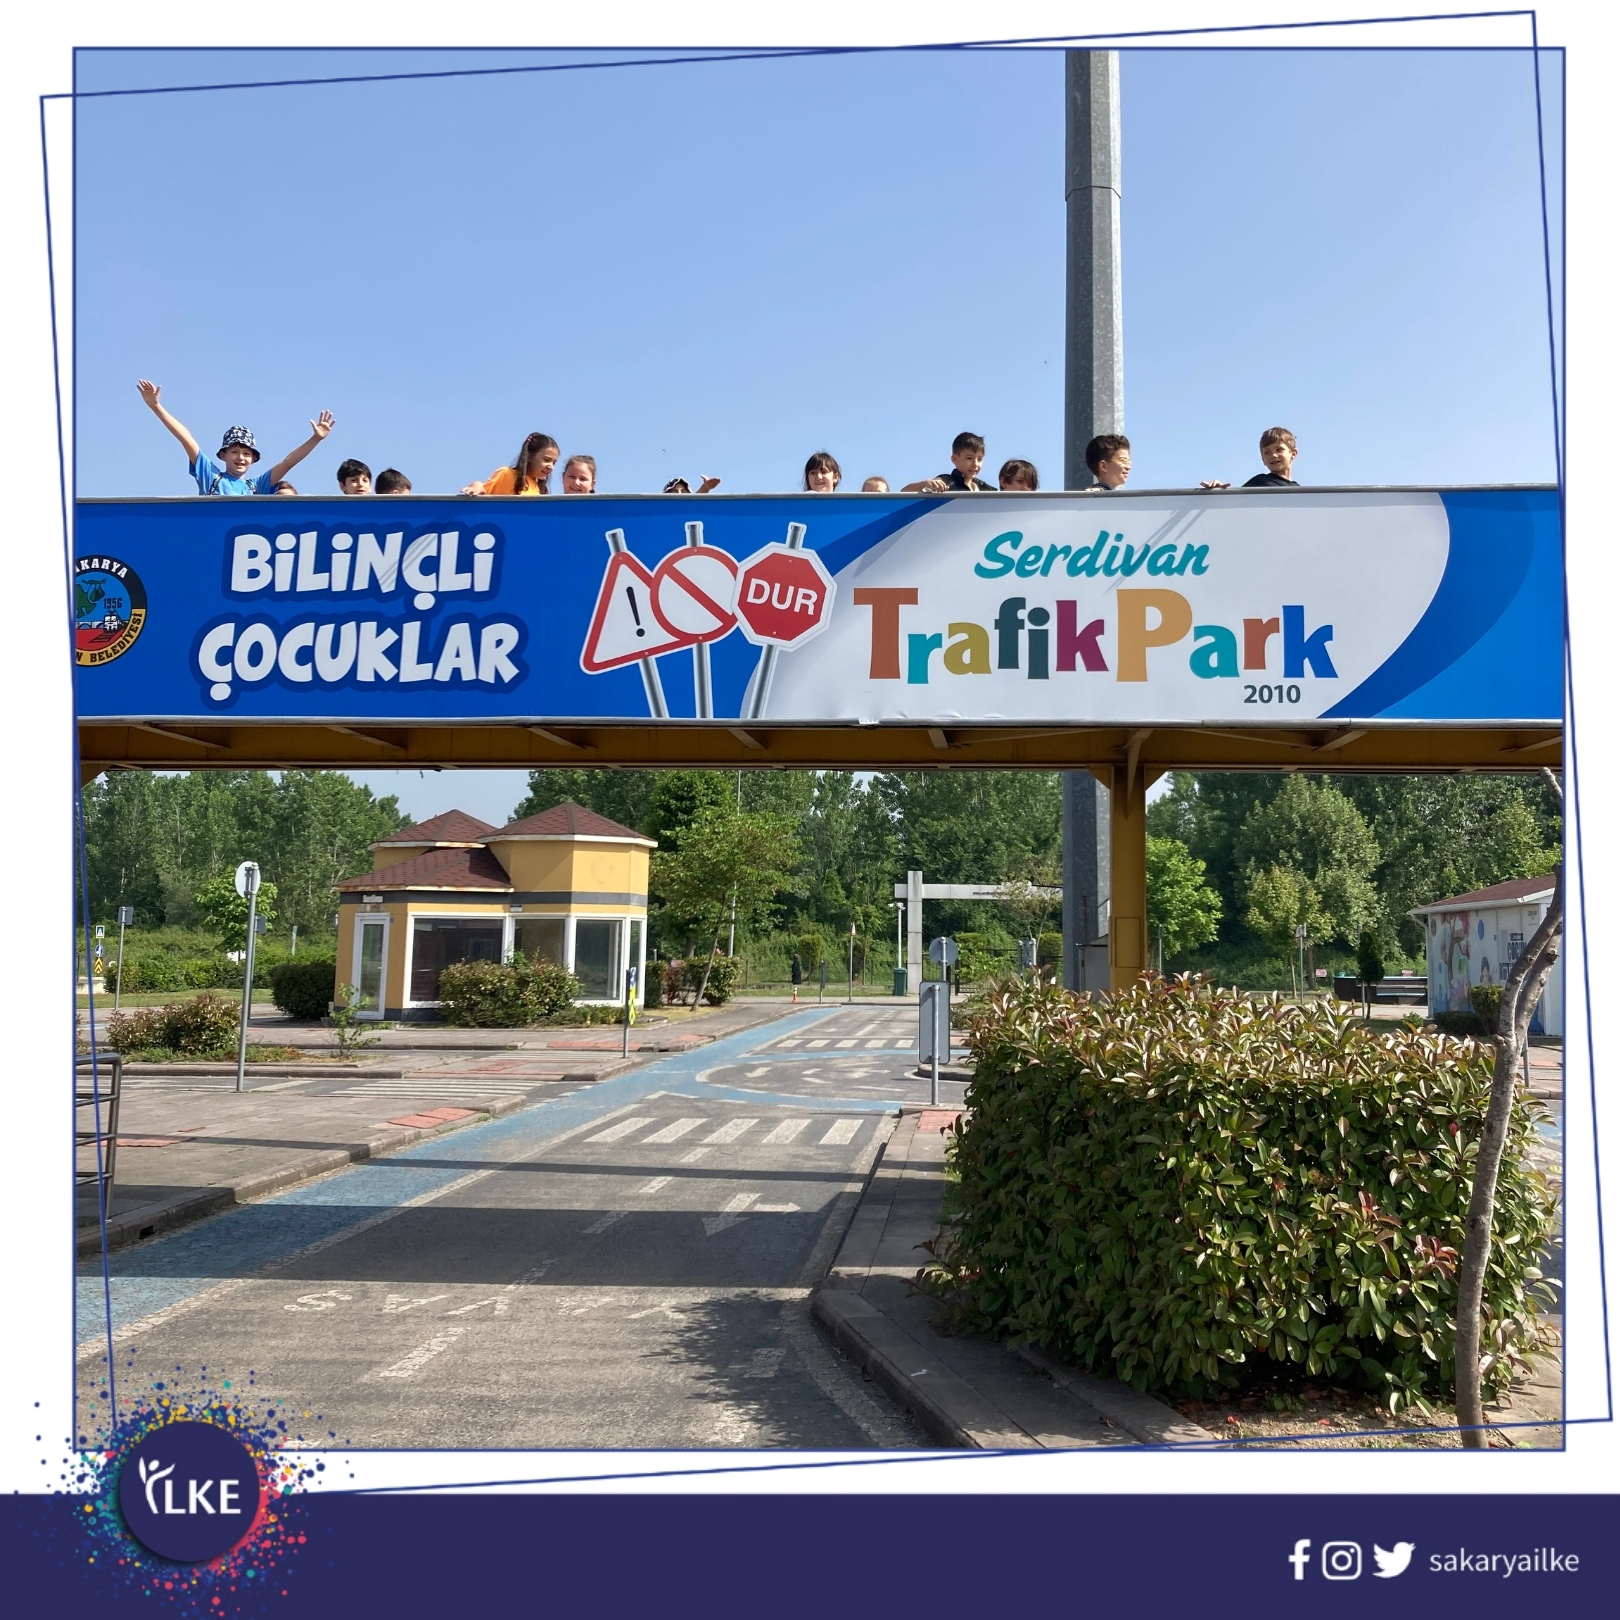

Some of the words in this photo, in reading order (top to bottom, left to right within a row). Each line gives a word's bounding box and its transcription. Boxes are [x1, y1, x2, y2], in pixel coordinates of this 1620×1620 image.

[974, 530, 1209, 579] Serdivan
[104, 597, 122, 609] 1956
[747, 578, 818, 616] DUR
[199, 621, 520, 701] ÇOCUKLAR
[1243, 685, 1300, 704] 2010
